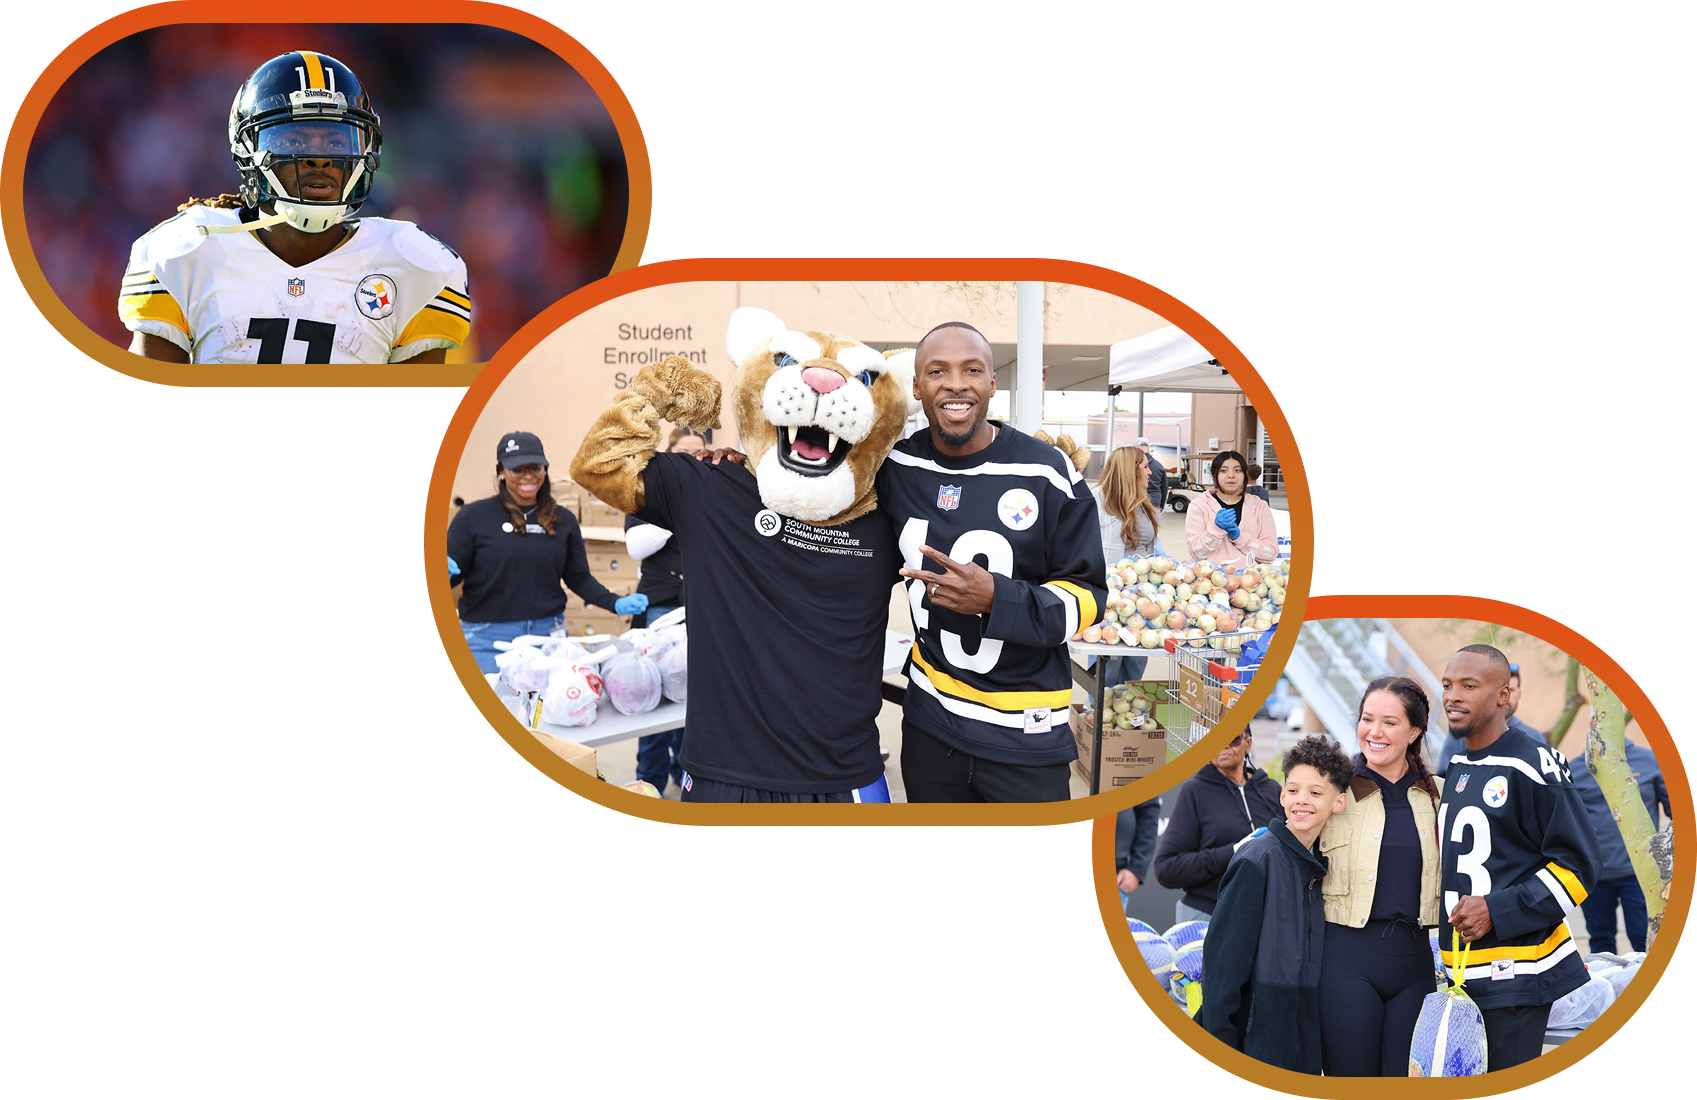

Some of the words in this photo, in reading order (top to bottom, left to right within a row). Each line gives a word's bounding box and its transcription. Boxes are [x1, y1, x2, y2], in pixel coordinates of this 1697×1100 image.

[304, 89, 333, 99] Steelers
[289, 285, 303, 294] NFL
[360, 288, 377, 298] Steelers
[618, 323, 692, 340] Student
[246, 318, 336, 364] 11
[614, 372, 634, 389] S
[939, 495, 957, 507] NFL
[784, 525, 833, 543] COMMUNITY
[833, 537, 860, 546] COLLEGE
[786, 518, 812, 532] SOUTH
[813, 527, 849, 538] MOUNTAIN
[787, 538, 820, 552] MARICOPA
[820, 547, 853, 556] COMMUNITY
[1186, 679, 1198, 698] 12
